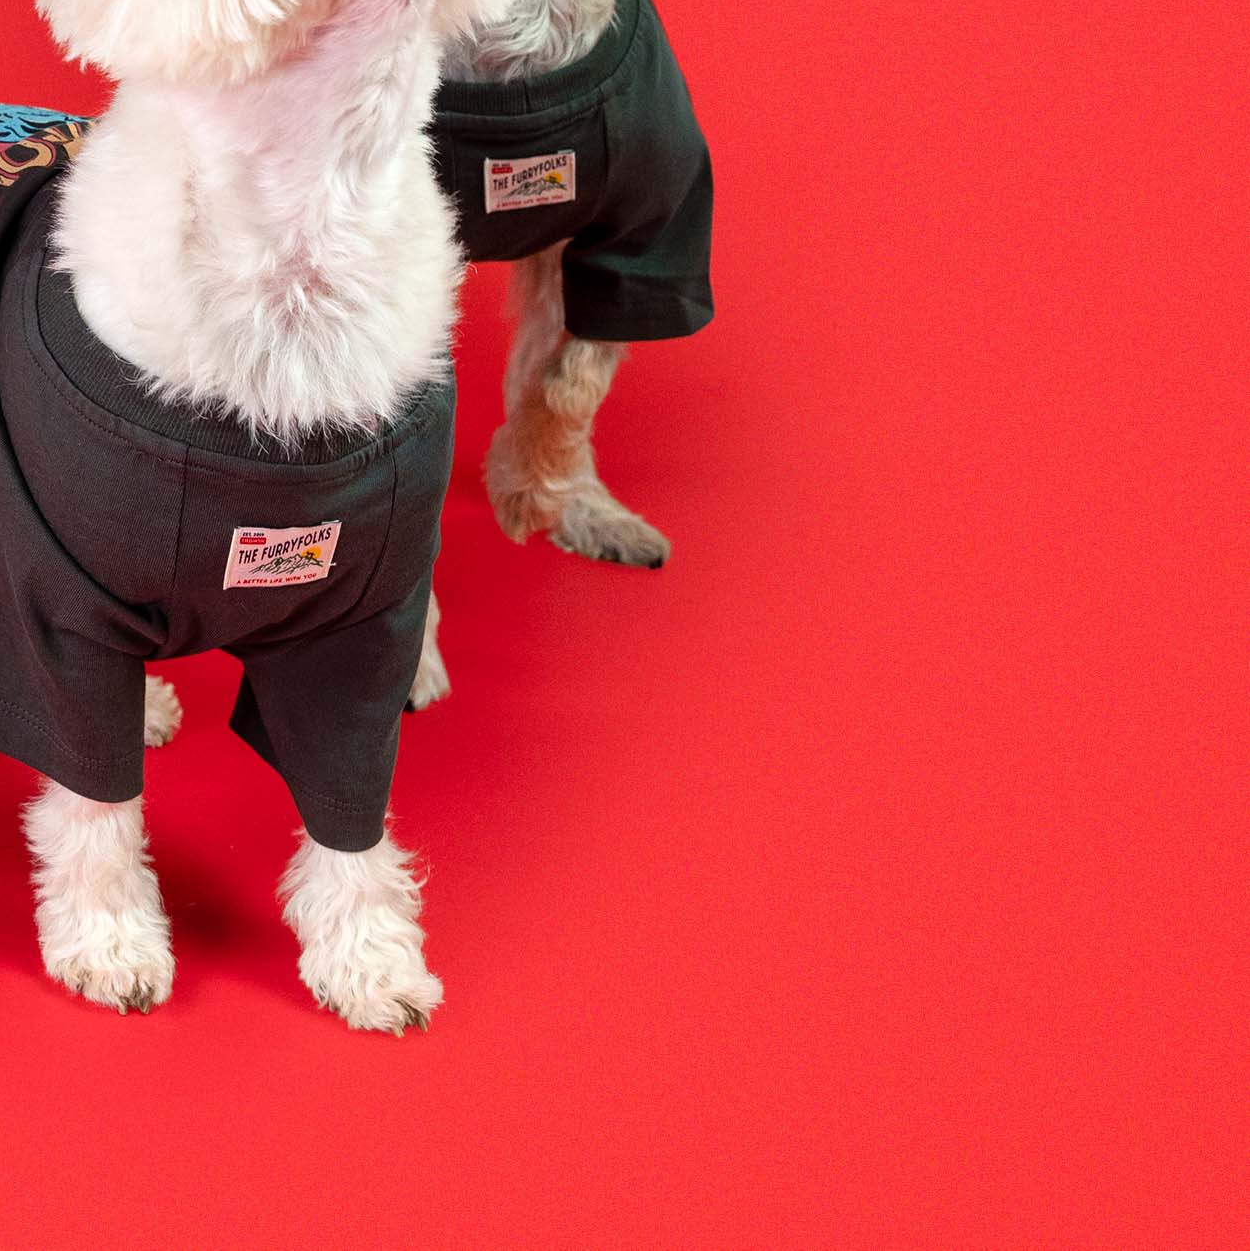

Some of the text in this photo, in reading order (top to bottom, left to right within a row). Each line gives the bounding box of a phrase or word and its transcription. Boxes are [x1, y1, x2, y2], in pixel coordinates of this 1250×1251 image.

[493, 155, 567, 191] THE FURRYFOLKS
[238, 527, 332, 565] THE FURRYFOLKS
[285, 575, 301, 583] WITH
